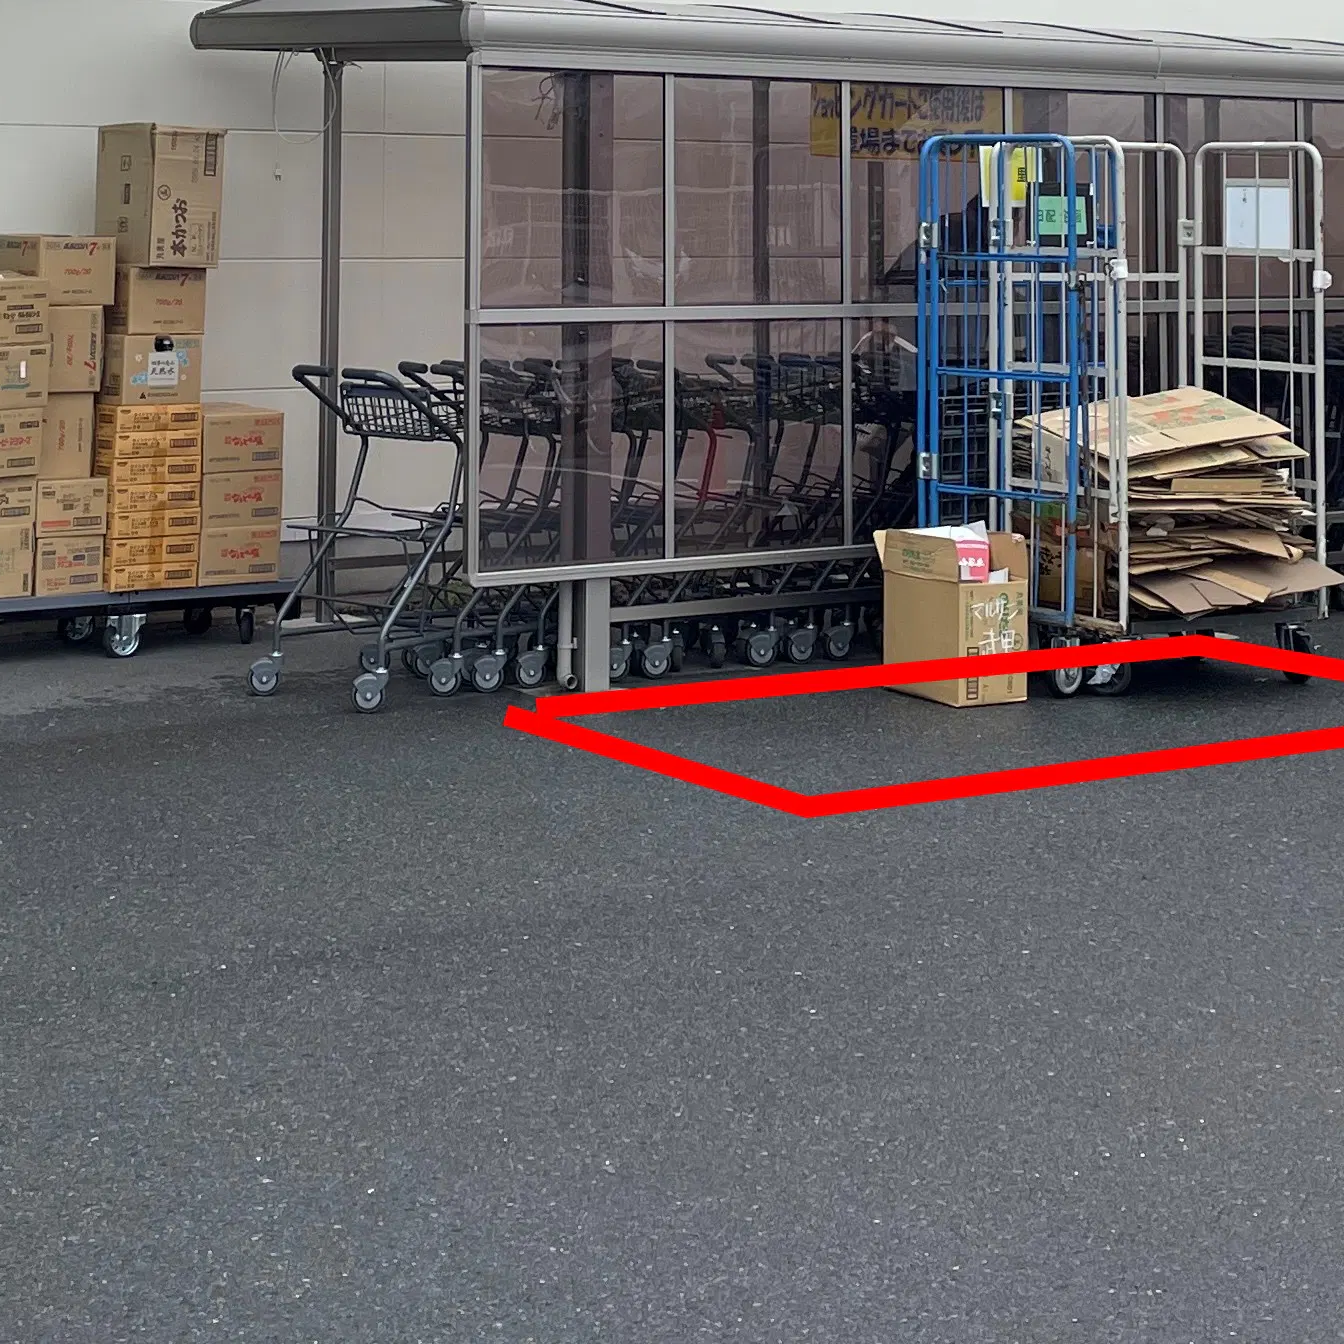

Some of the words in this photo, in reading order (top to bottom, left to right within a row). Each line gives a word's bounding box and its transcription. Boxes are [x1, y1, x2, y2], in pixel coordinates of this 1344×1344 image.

[170, 197, 189, 258] 本かつお
[970, 597, 1020, 621] マルサン
